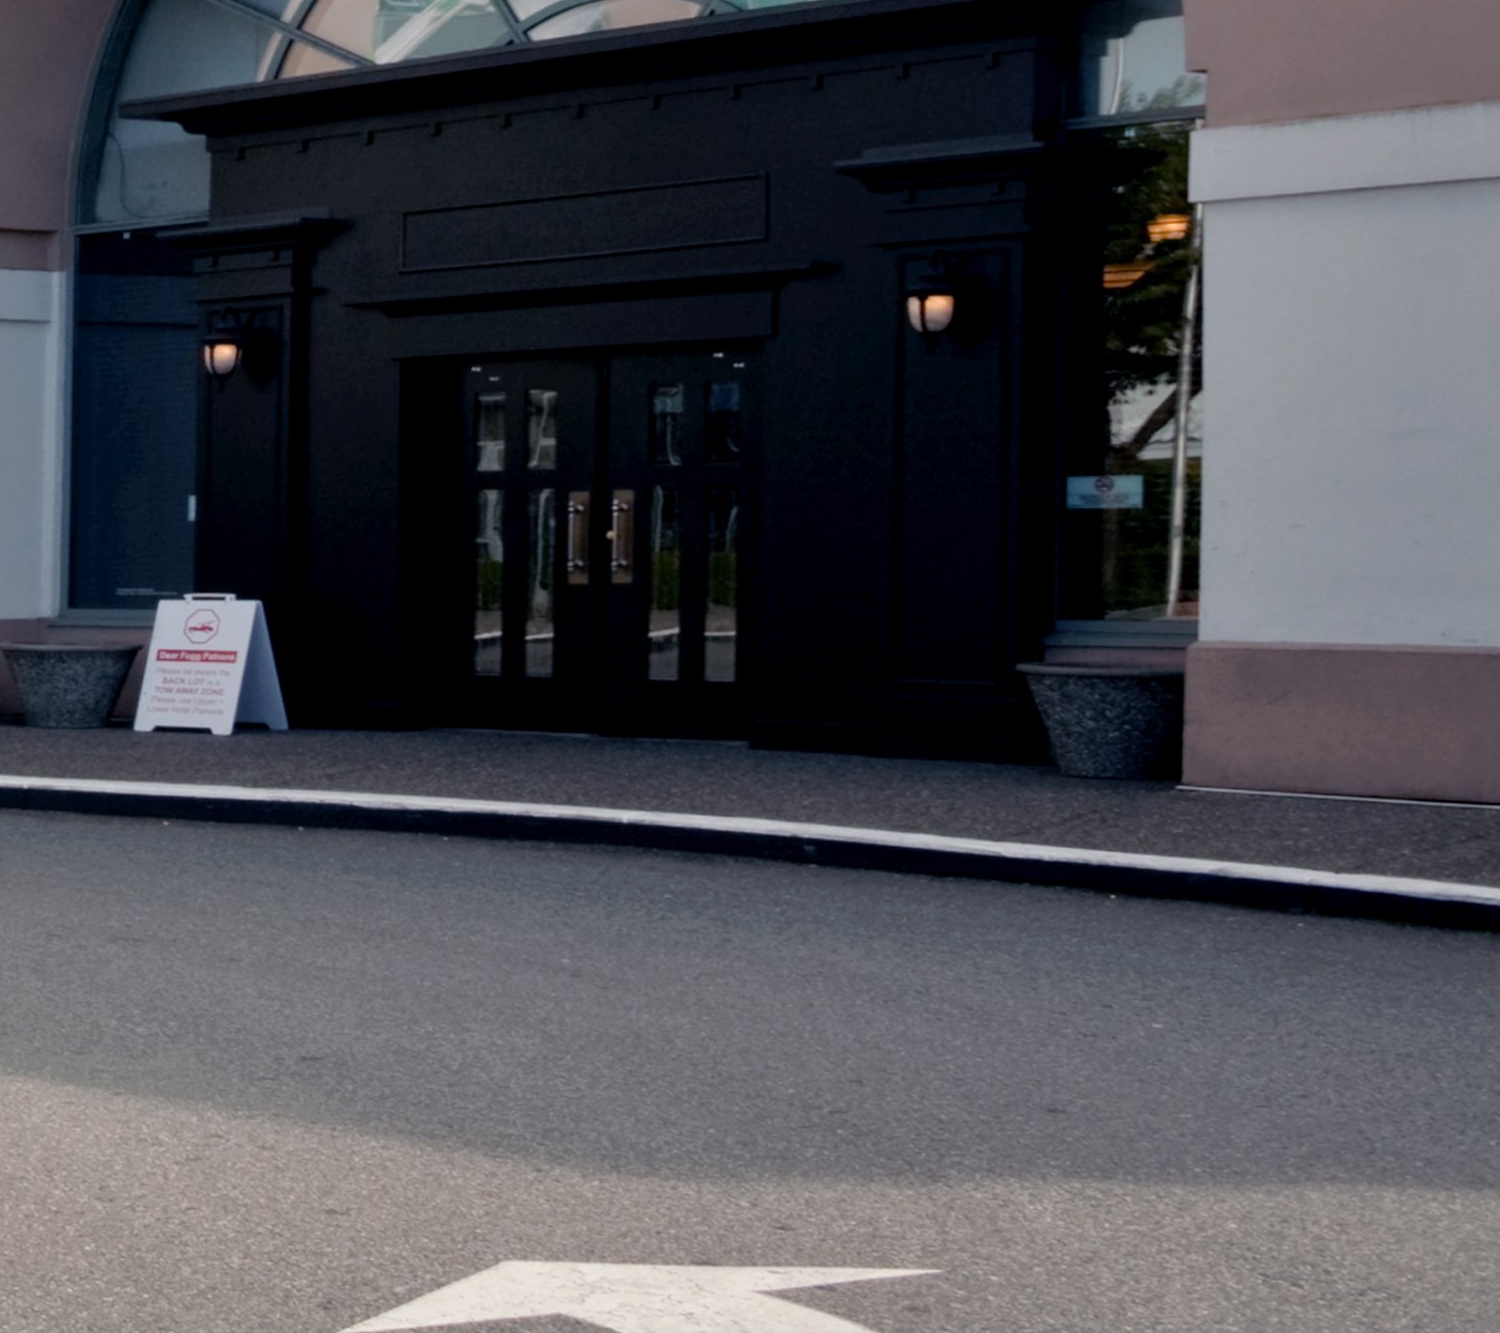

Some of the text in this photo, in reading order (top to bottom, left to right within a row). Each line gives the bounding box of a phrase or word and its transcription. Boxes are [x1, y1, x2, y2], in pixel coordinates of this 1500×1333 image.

[159, 651, 236, 662] Dear Fogg Patrons
[155, 686, 225, 696] TOW AWAY ZONE
